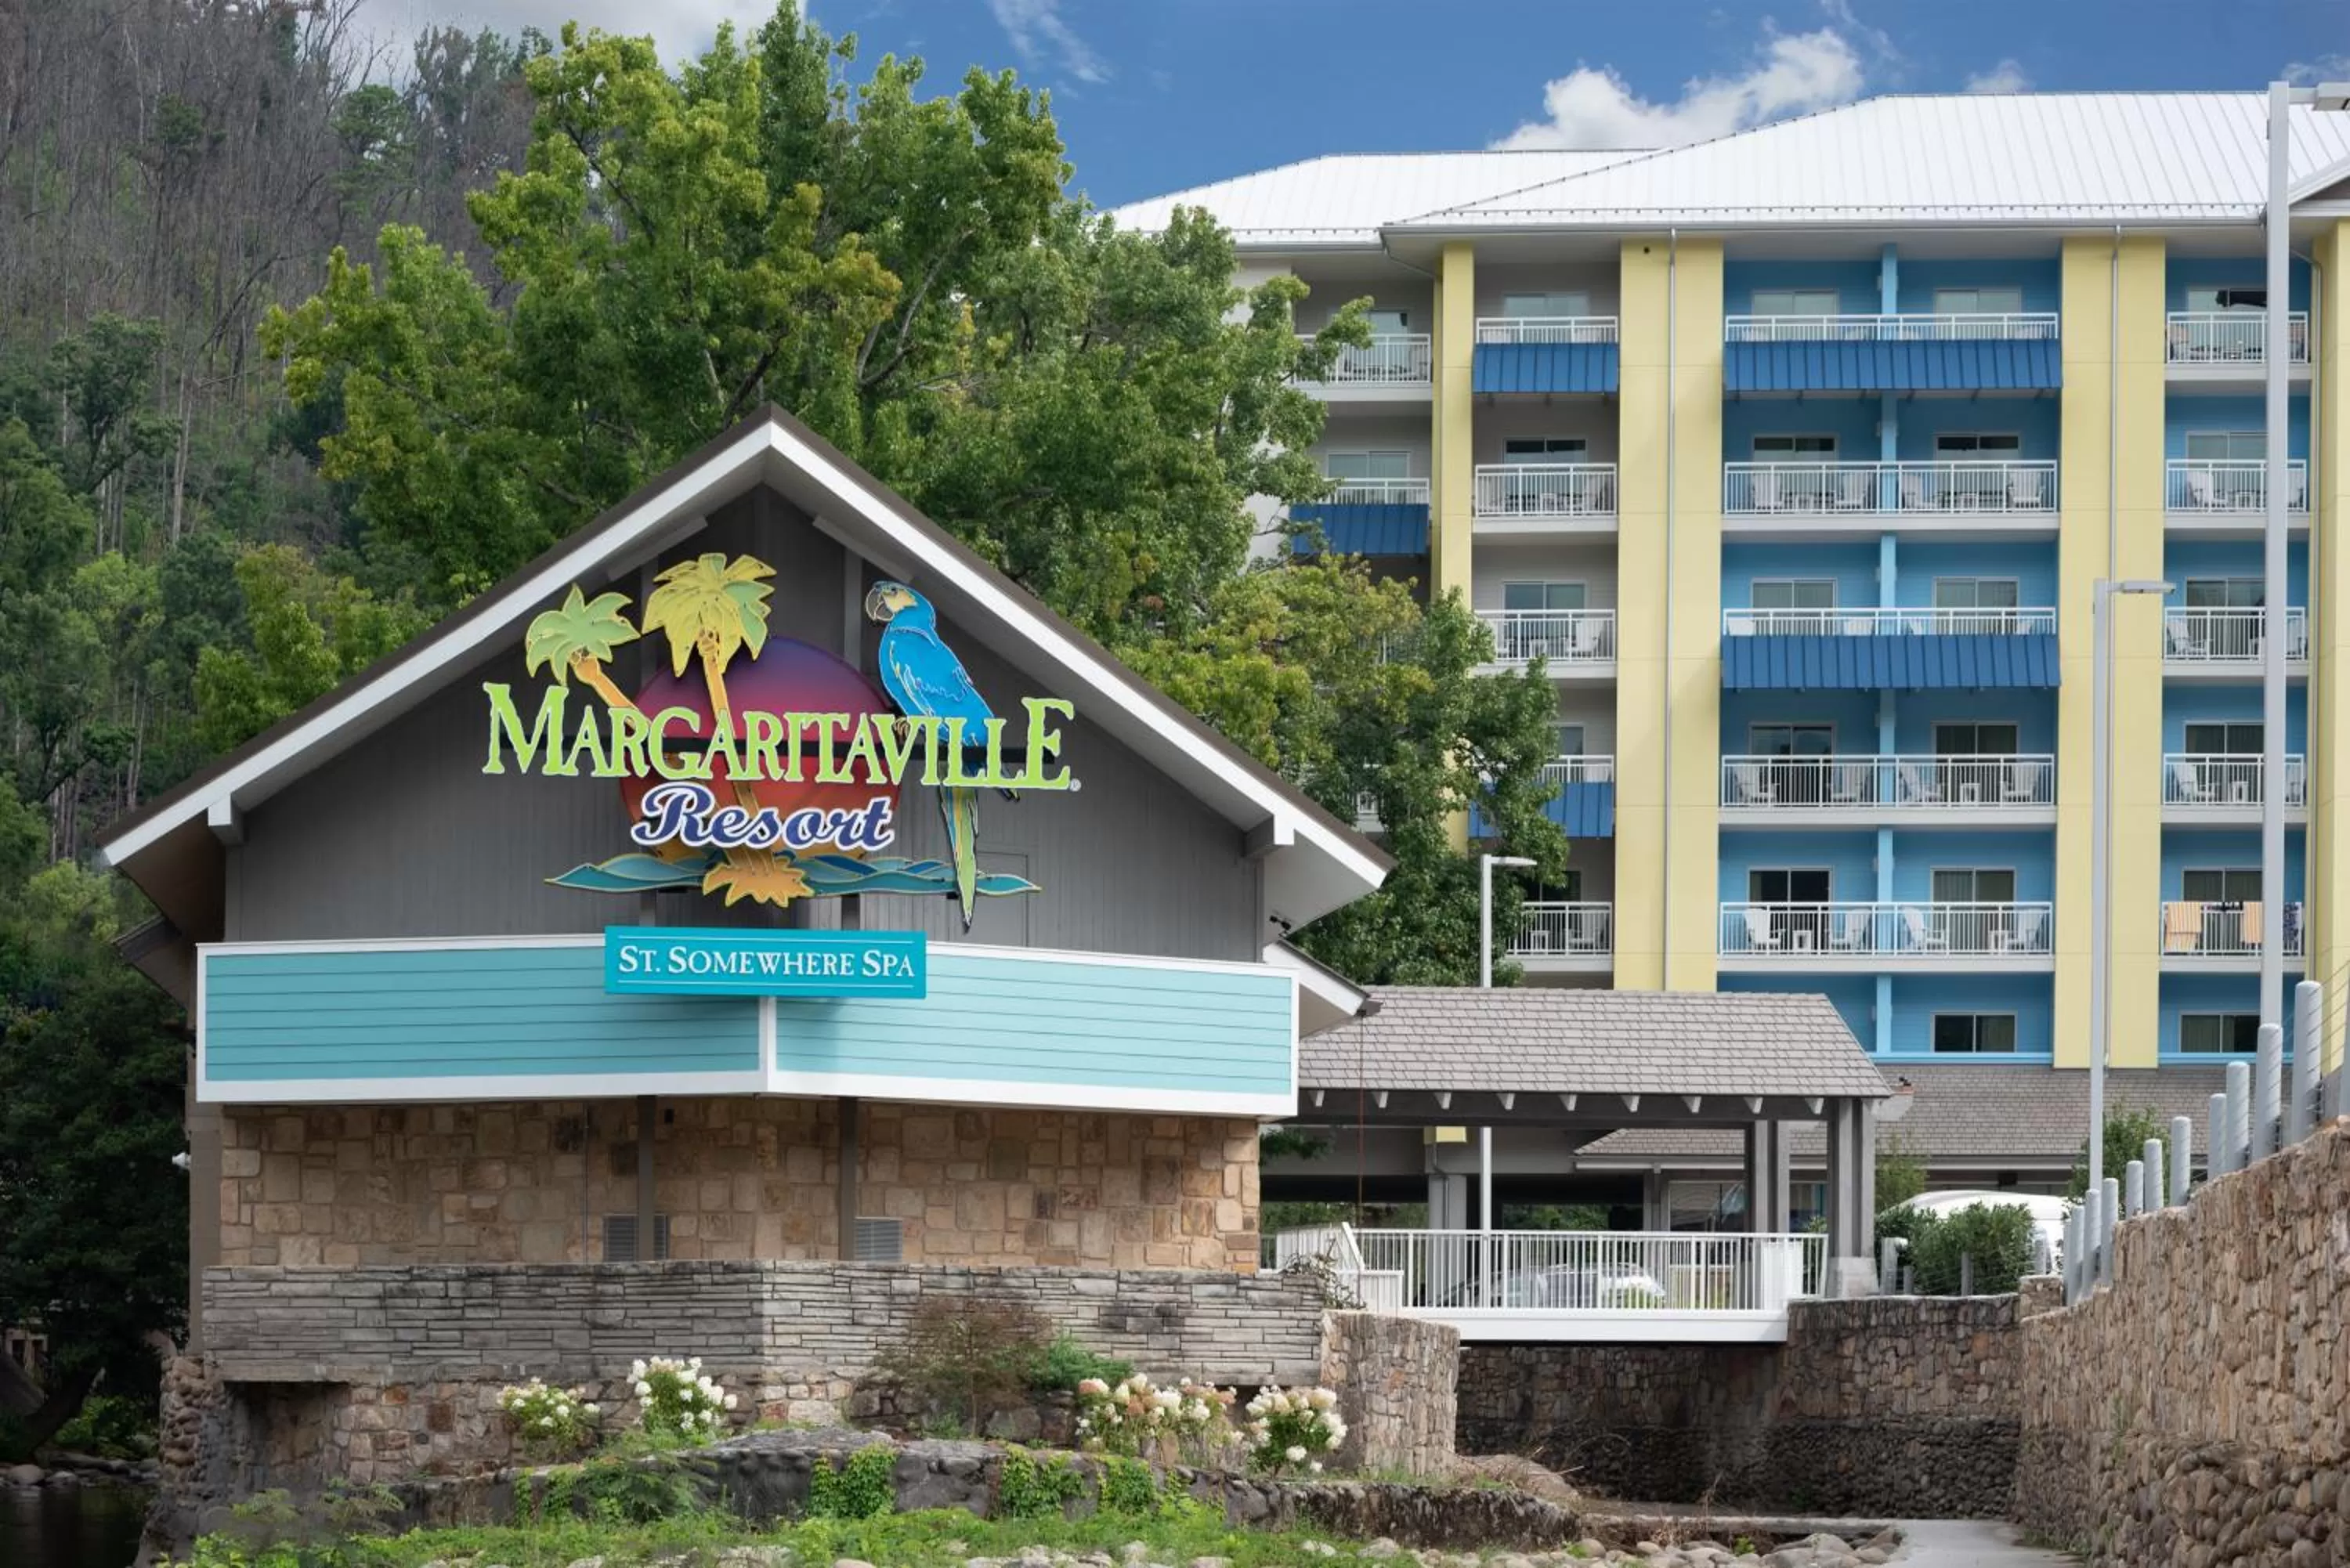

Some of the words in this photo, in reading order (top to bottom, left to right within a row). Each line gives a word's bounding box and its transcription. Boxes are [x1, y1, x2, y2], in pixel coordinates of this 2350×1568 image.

[482, 682, 1076, 790] MARGARITAVILLE
[631, 782, 898, 851] Resort
[618, 945, 660, 973] ST.
[667, 946, 855, 976] SOMEWHERE
[862, 950, 915, 977] SPA
